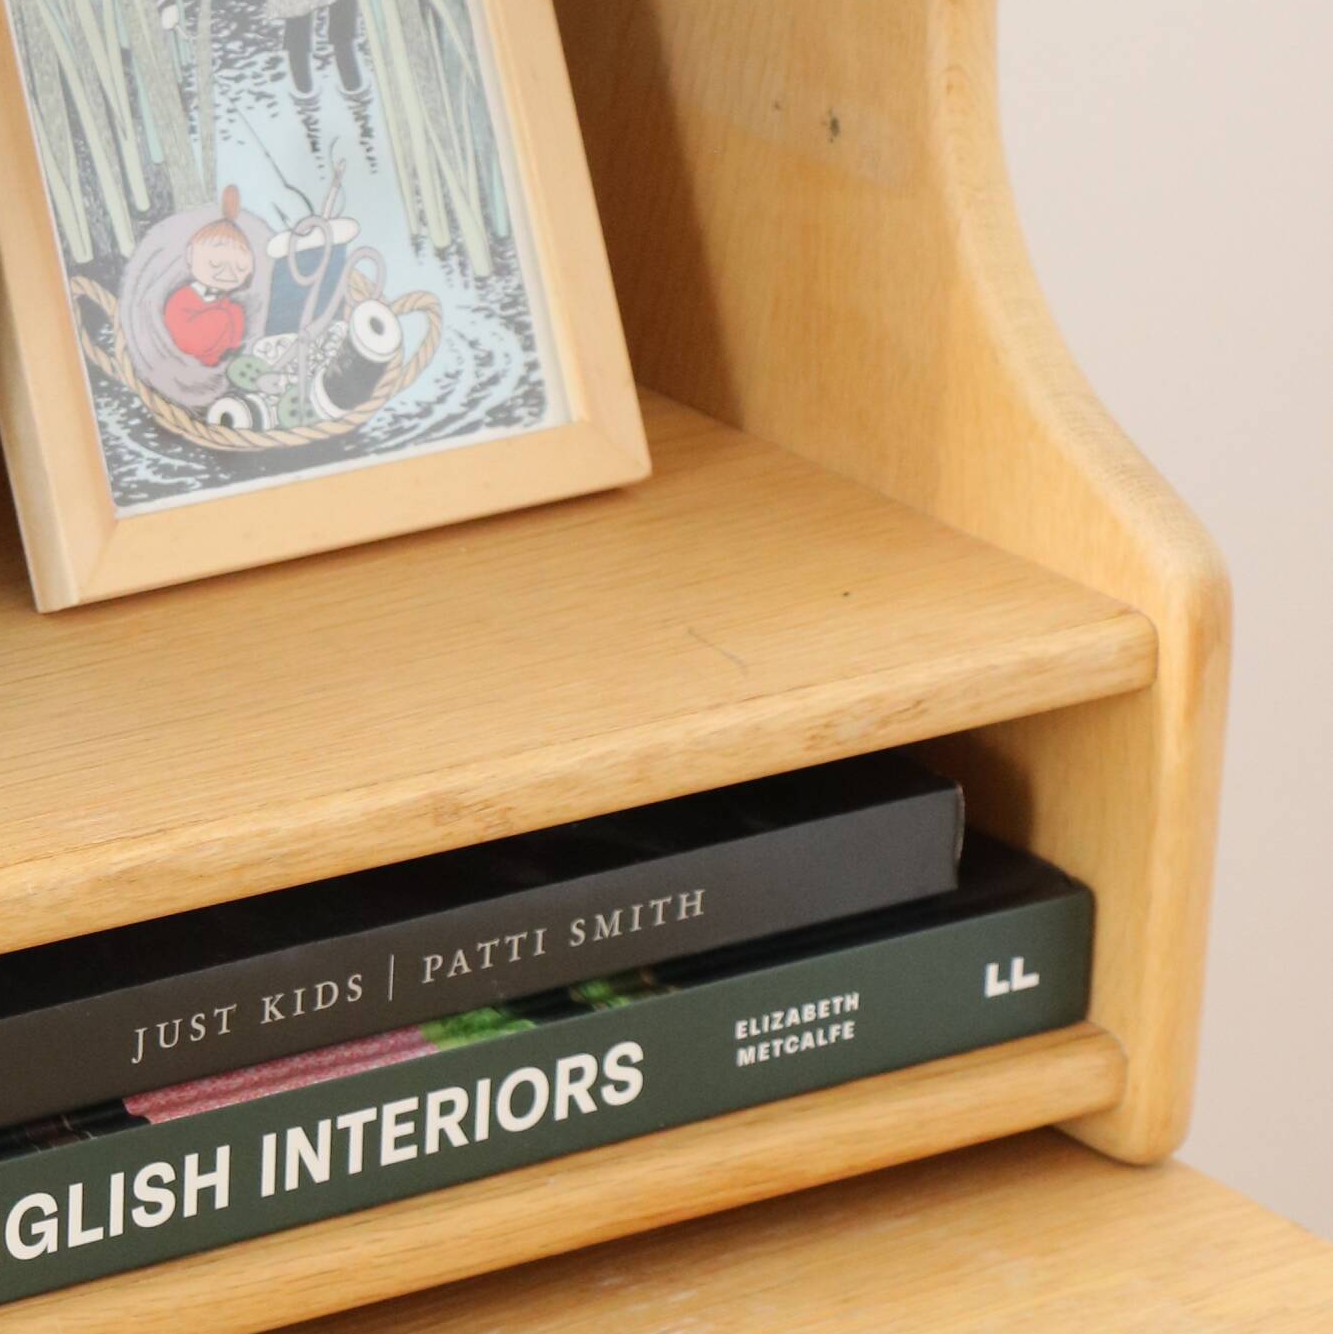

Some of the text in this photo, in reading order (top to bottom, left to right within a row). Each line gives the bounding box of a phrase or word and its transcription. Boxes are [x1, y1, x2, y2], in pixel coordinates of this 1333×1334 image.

[131, 889, 706, 1064] JUST KIDS PATTI SMITH
[984, 957, 1040, 998] LL
[735, 992, 860, 1040] ELIZABETH
[736, 1020, 855, 1067] METCALFE
[261, 1041, 644, 1198] INTERIORS
